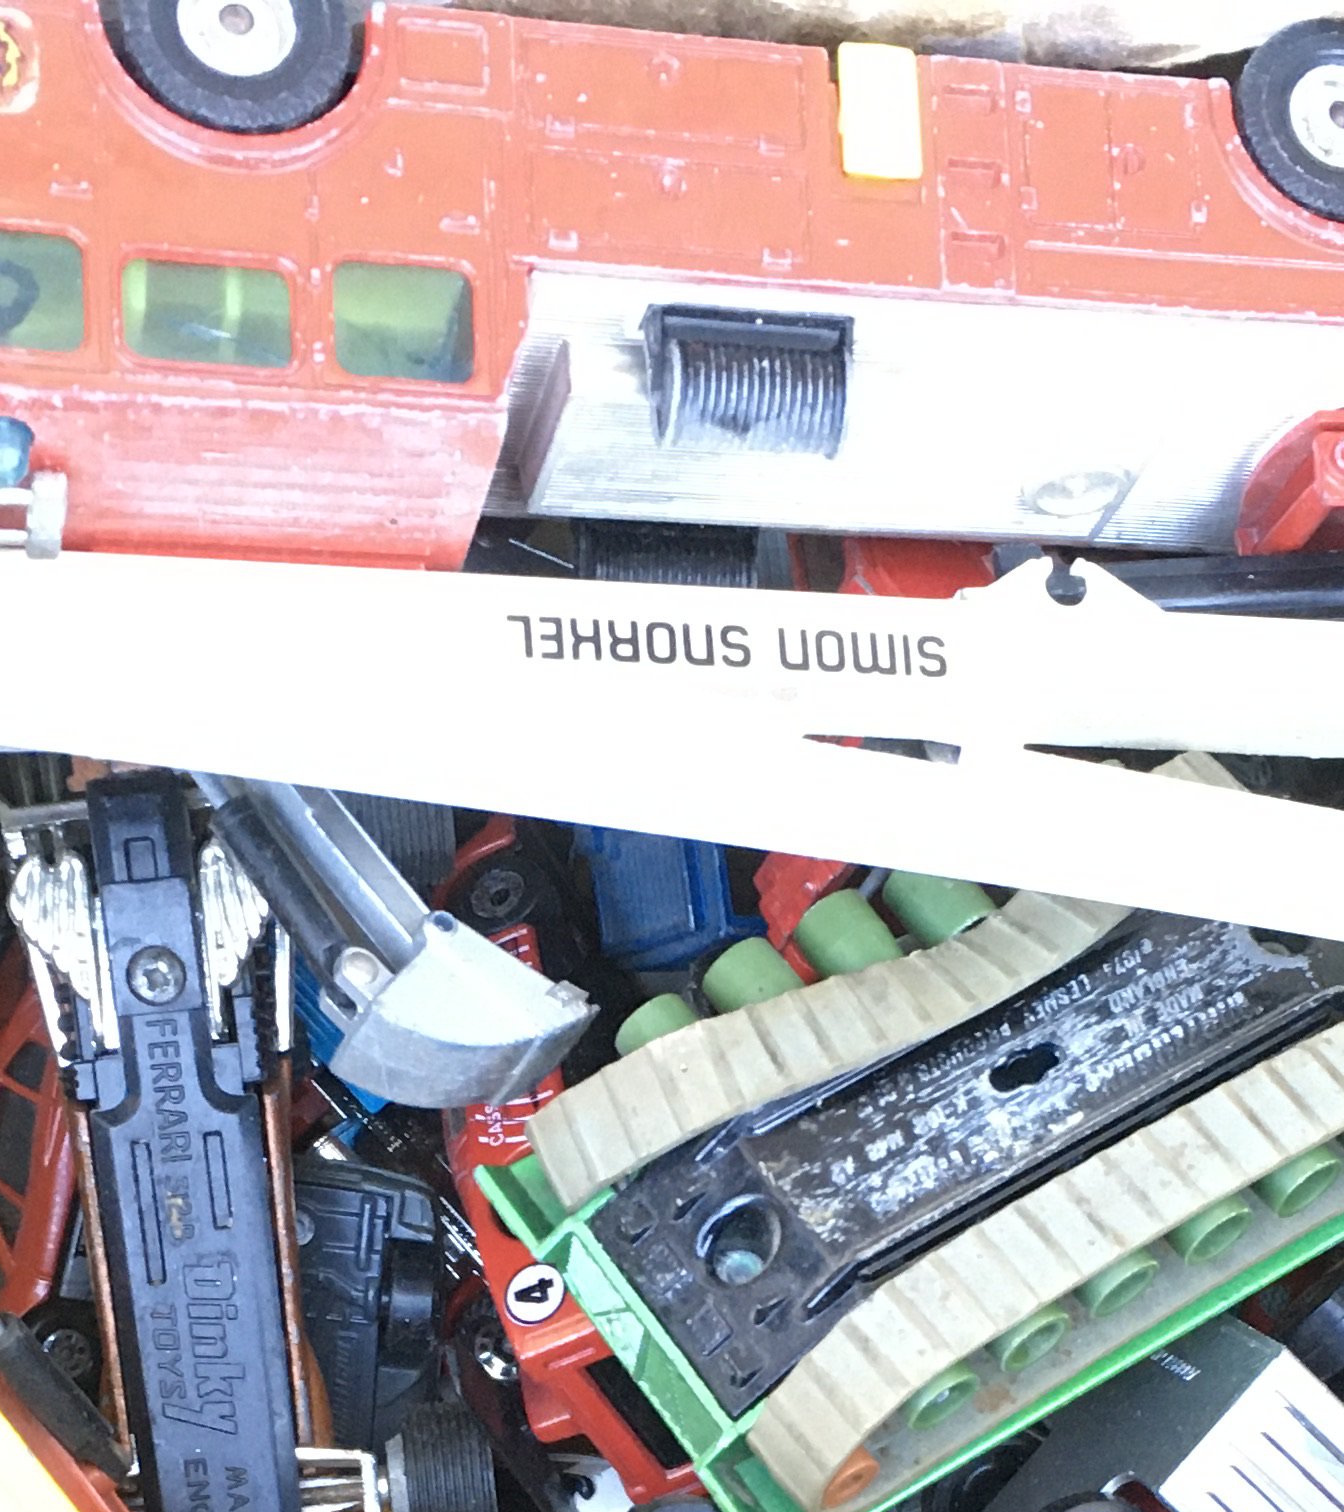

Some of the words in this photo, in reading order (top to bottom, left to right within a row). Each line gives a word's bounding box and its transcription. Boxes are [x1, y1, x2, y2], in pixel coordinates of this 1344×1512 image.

[506, 614, 752, 668] SNORKEL
[777, 626, 948, 678] SIMON
[143, 1017, 193, 1163] FERRARI
[511, 1276, 556, 1306] 4
[149, 1303, 187, 1400] TOYS
[162, 1259, 238, 1434] Dinky
